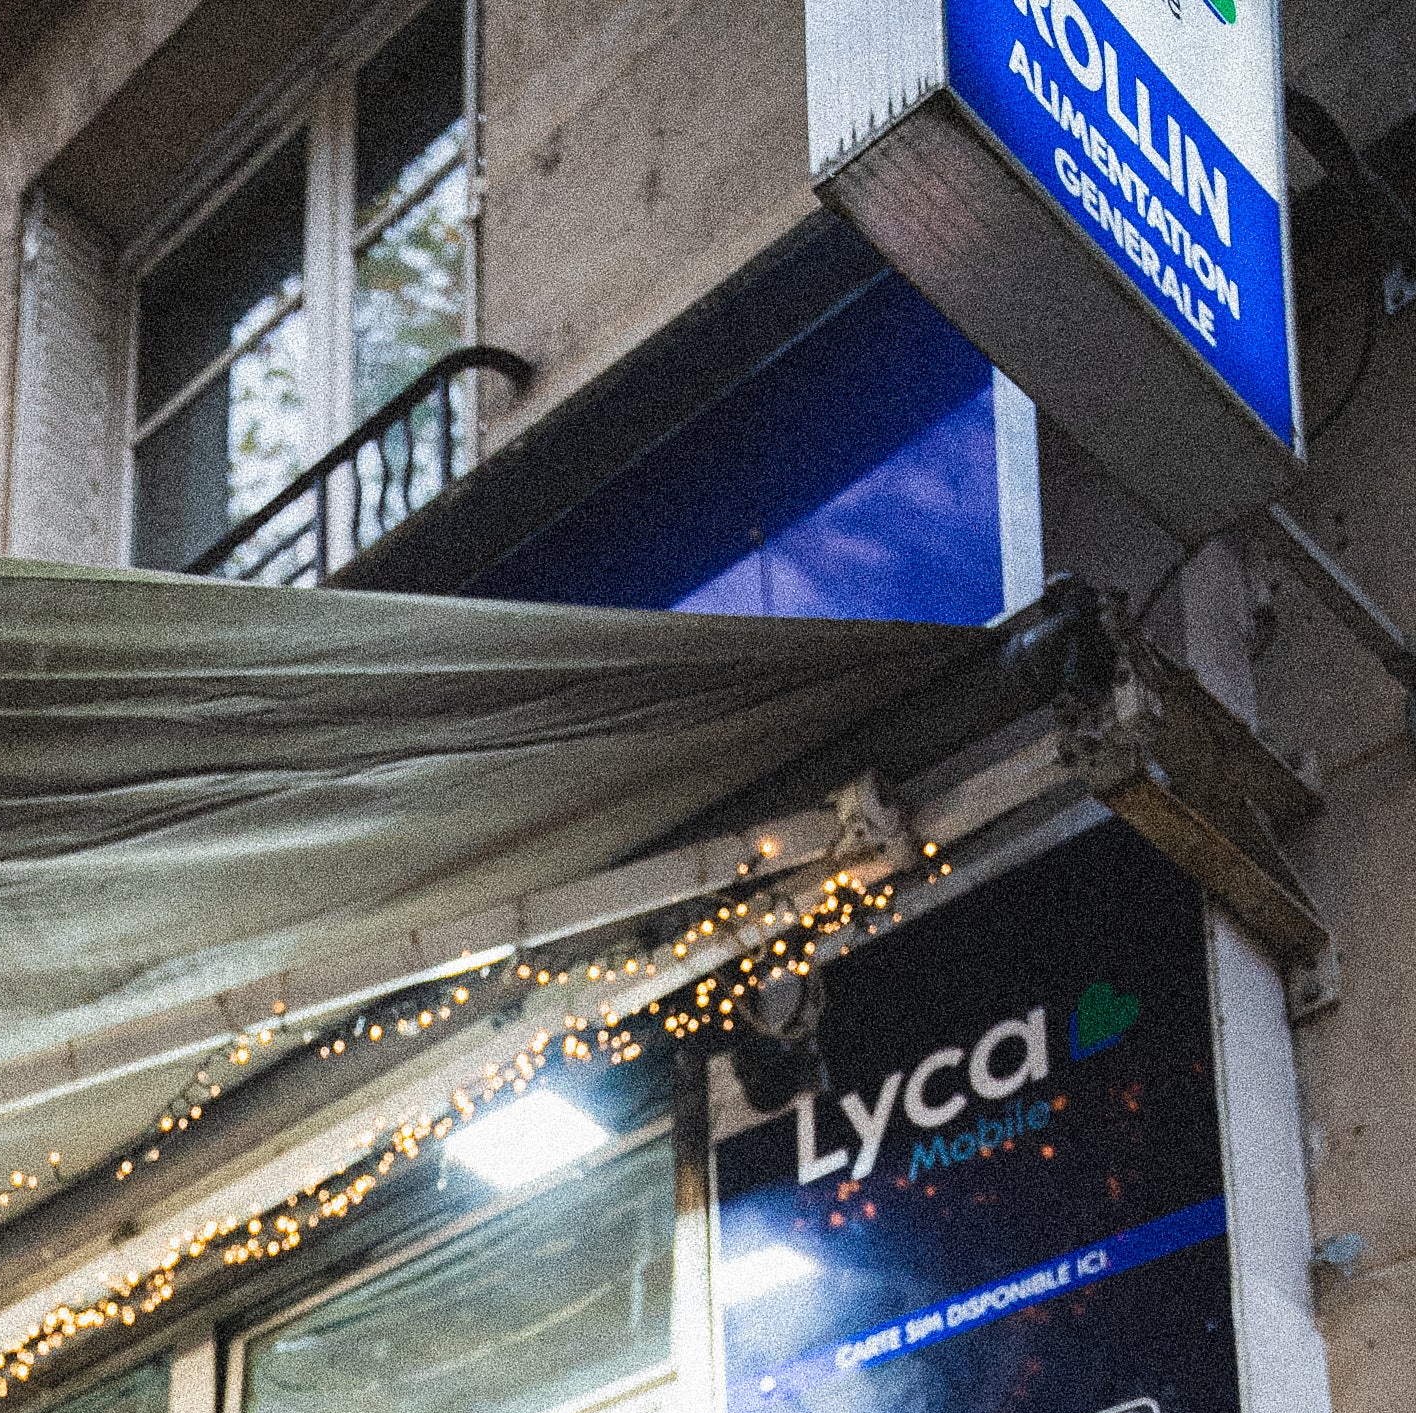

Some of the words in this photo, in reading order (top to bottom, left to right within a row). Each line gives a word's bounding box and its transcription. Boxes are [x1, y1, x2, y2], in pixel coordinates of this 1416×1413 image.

[1008, 39, 1240, 320] ALIMENTATION
[1053, 147, 1217, 348] GENERALE
[908, 1098, 1052, 1182] Mobile
[945, 1261, 1072, 1329] DISPONIBLE
[1076, 1250, 1109, 1278] ICI
